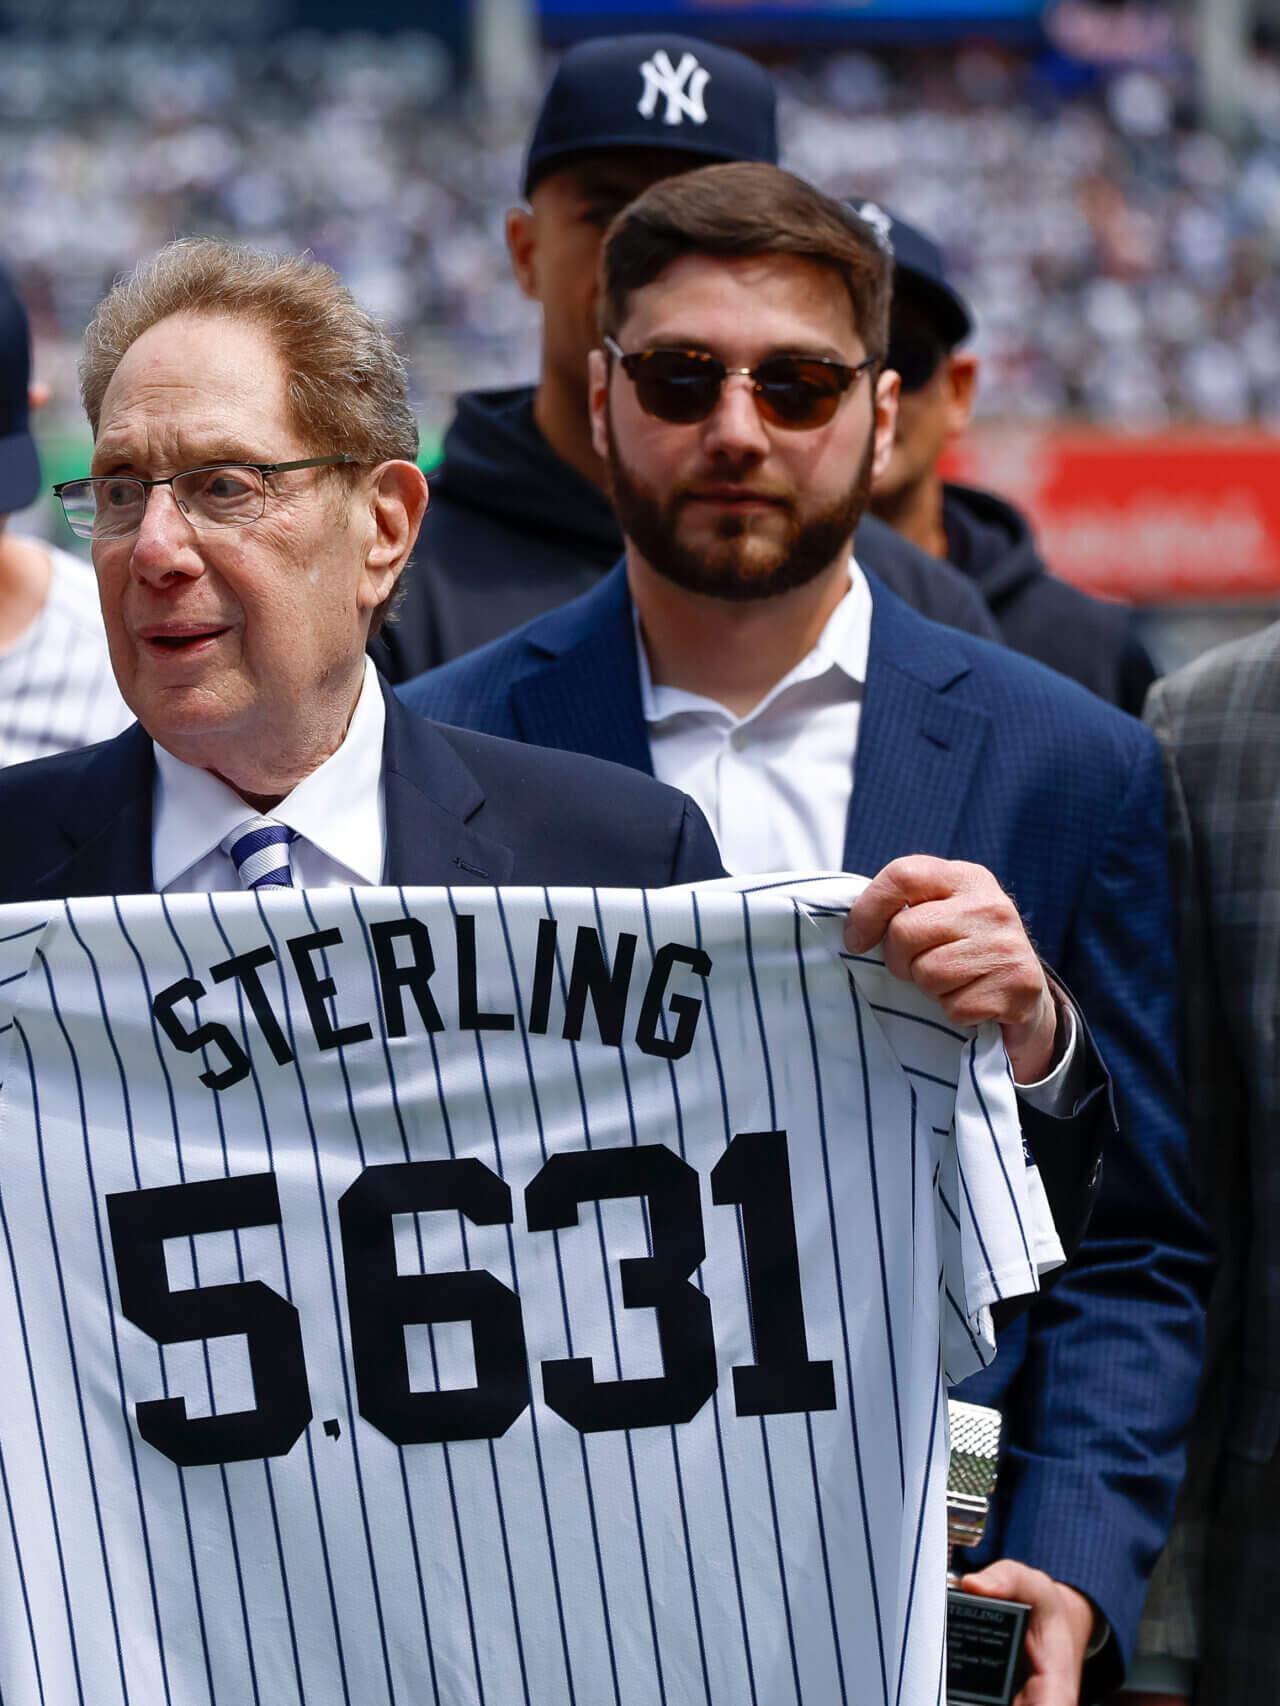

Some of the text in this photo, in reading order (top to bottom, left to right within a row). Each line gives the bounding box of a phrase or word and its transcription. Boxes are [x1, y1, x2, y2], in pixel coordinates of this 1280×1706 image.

[638, 50, 709, 125] NY
[152, 915, 712, 1091] STERLING
[106, 1130, 837, 1467] 5,631
